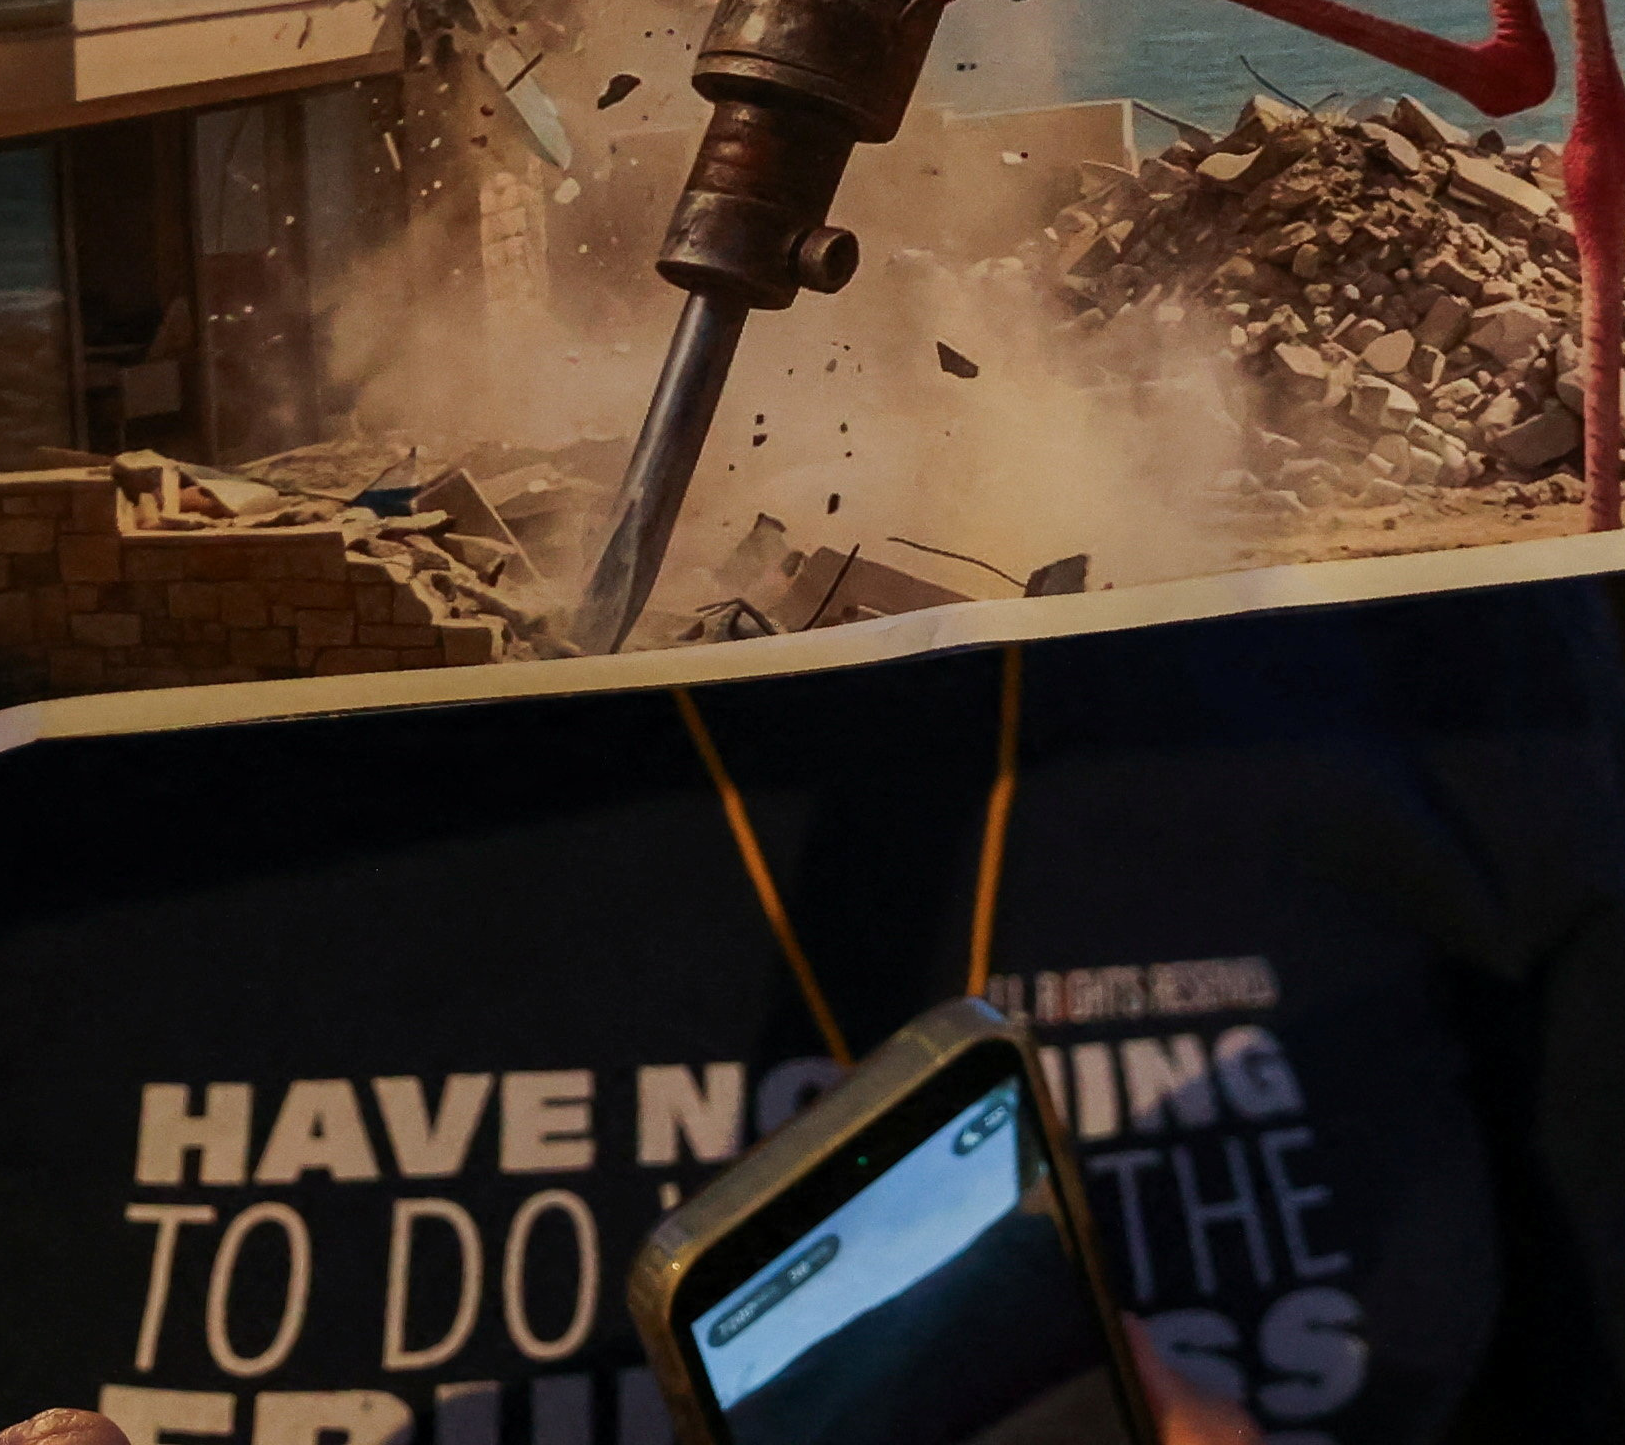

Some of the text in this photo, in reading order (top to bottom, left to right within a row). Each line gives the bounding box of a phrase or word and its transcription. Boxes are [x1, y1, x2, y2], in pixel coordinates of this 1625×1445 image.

[135, 1070, 596, 1186] HAVE
[126, 1201, 313, 1378] TO
[381, 1189, 600, 1372] DO
[1087, 1127, 1352, 1303] THE
